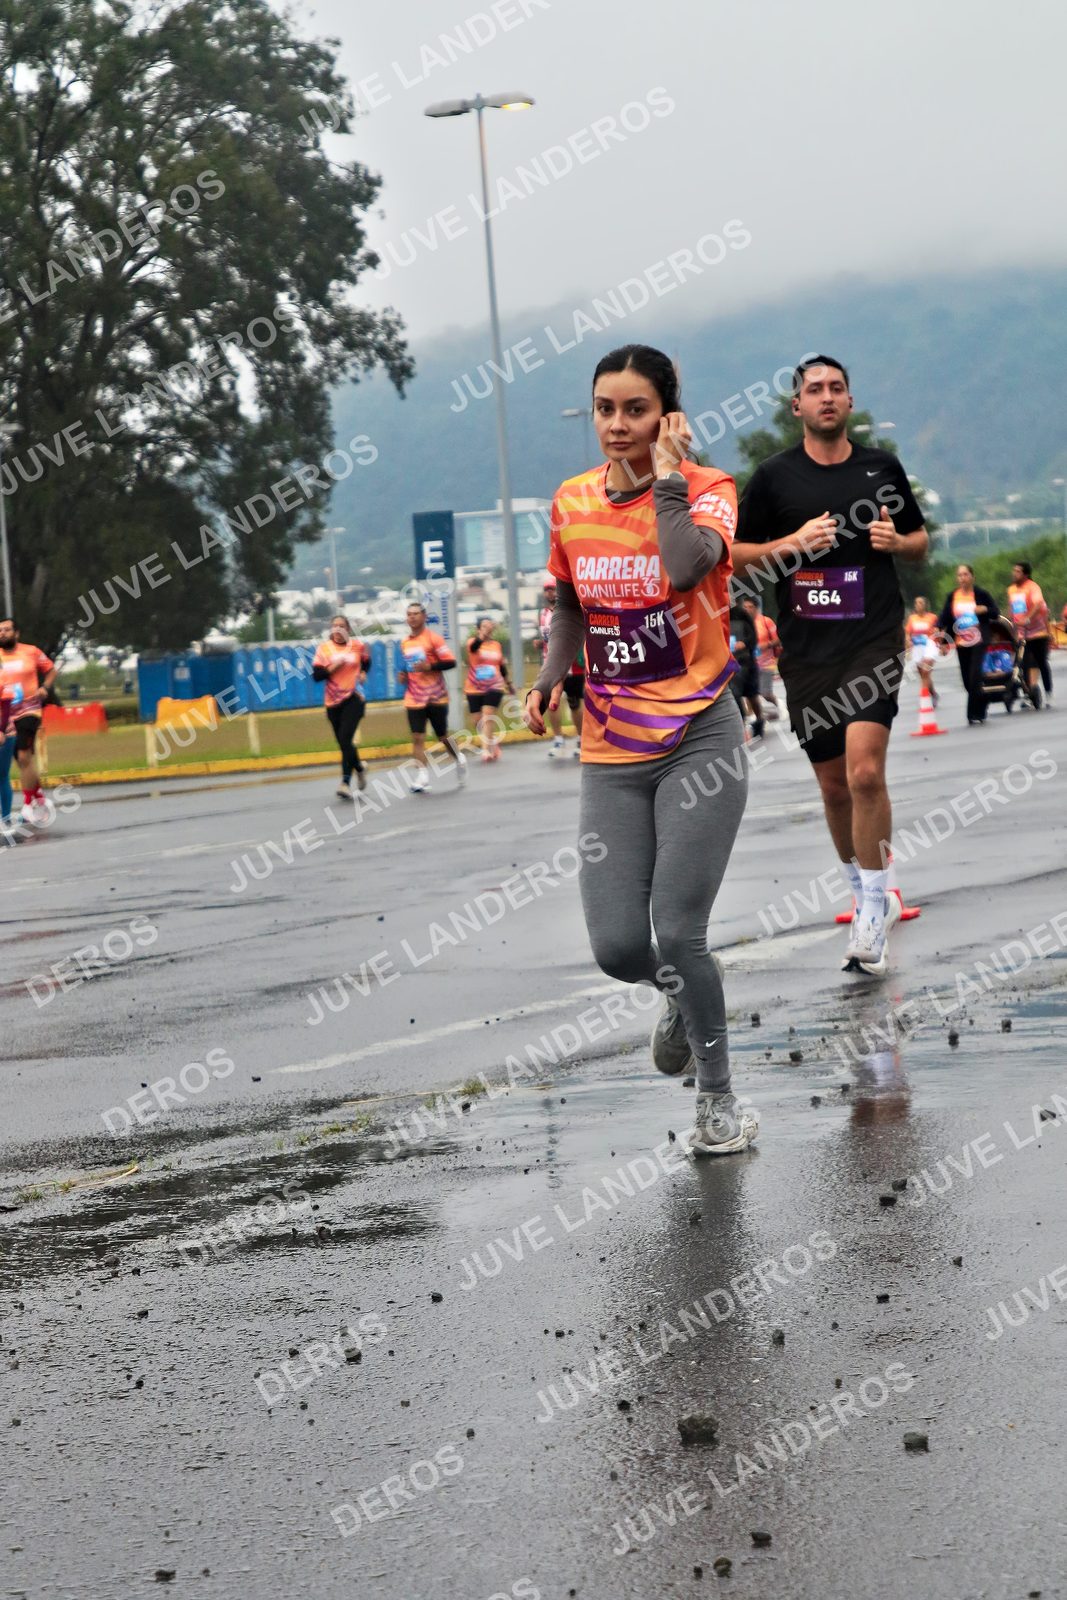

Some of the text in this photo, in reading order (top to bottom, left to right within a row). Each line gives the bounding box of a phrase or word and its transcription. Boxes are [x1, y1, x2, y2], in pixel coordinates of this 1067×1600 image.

[422, 540, 445, 570] E
[576, 555, 660, 580] CARRERA
[844, 571, 858, 582] 15K
[578, 583, 639, 598] OMNILIFE
[808, 590, 841, 605] 664
[589, 613, 619, 626] CARRERA
[644, 610, 665, 629] 15K
[590, 626, 614, 635] OMNILIFE
[607, 641, 645, 664] 231
